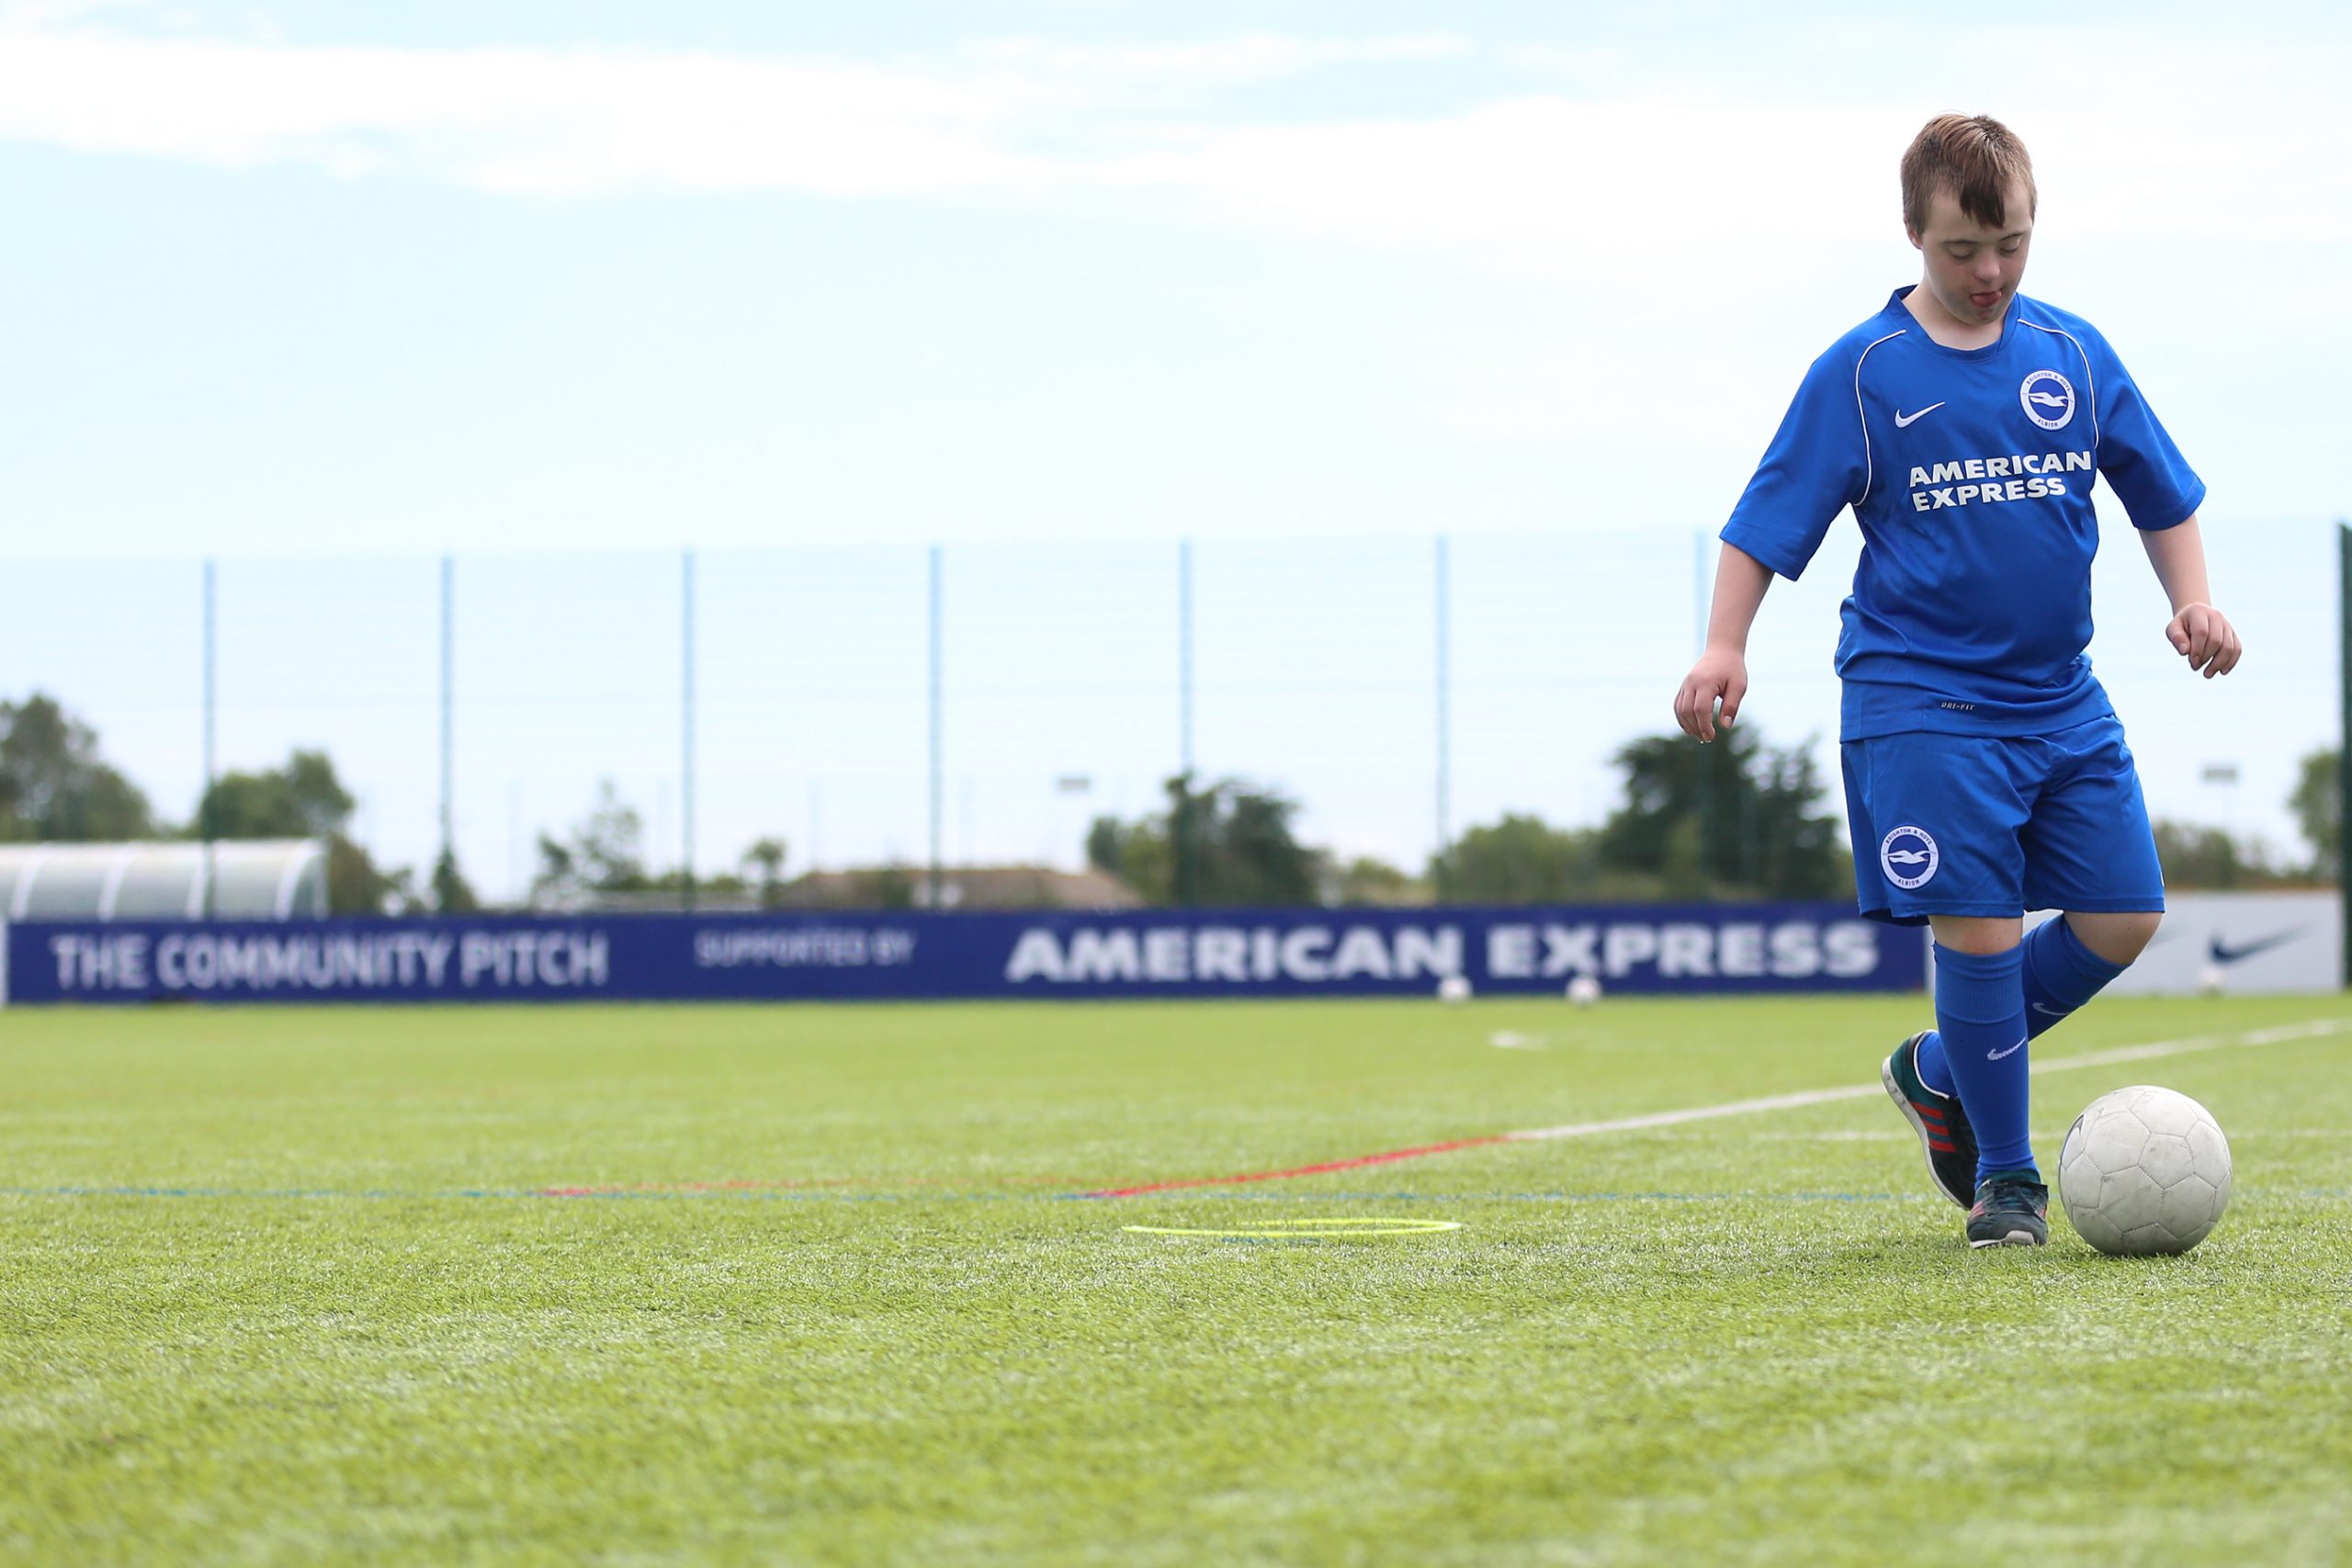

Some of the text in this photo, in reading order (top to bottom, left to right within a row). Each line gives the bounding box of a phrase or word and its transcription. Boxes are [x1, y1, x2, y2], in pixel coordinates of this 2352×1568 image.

[2038, 419, 2058, 427] ALBION
[1909, 450, 2092, 488] AMERICAN
[1912, 478, 2066, 513] EXPRESS
[53, 931, 609, 990] THE COMMUNITY PITCH
[695, 928, 915, 967] SUPPORTED BY
[1005, 920, 1880, 983] AMERICAN EXPRESS
